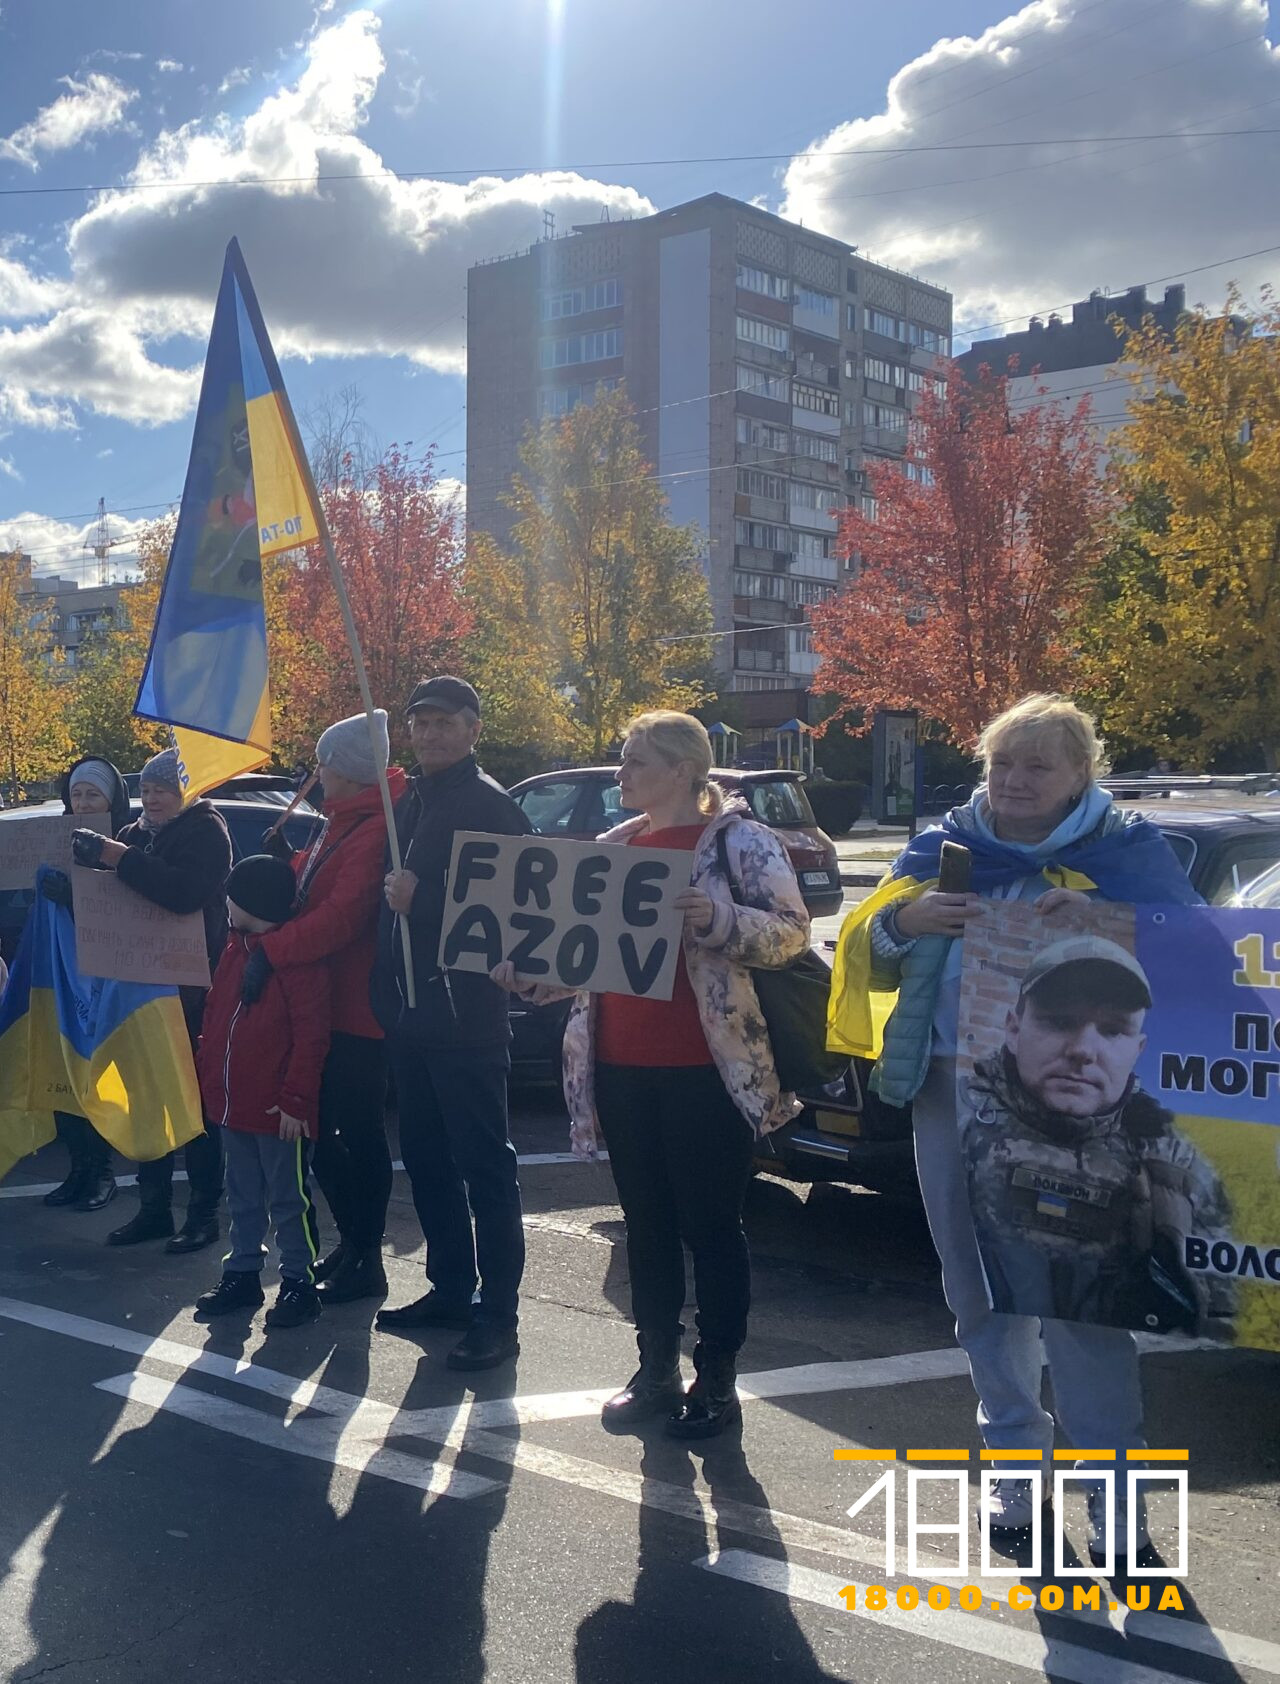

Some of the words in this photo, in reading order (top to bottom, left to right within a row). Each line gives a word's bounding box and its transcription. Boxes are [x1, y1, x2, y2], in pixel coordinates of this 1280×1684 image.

[452, 841, 671, 928] FREE
[442, 904, 669, 995] AZOV
[1233, 1012, 1280, 1053] П
[1160, 1052, 1280, 1100] МОГ
